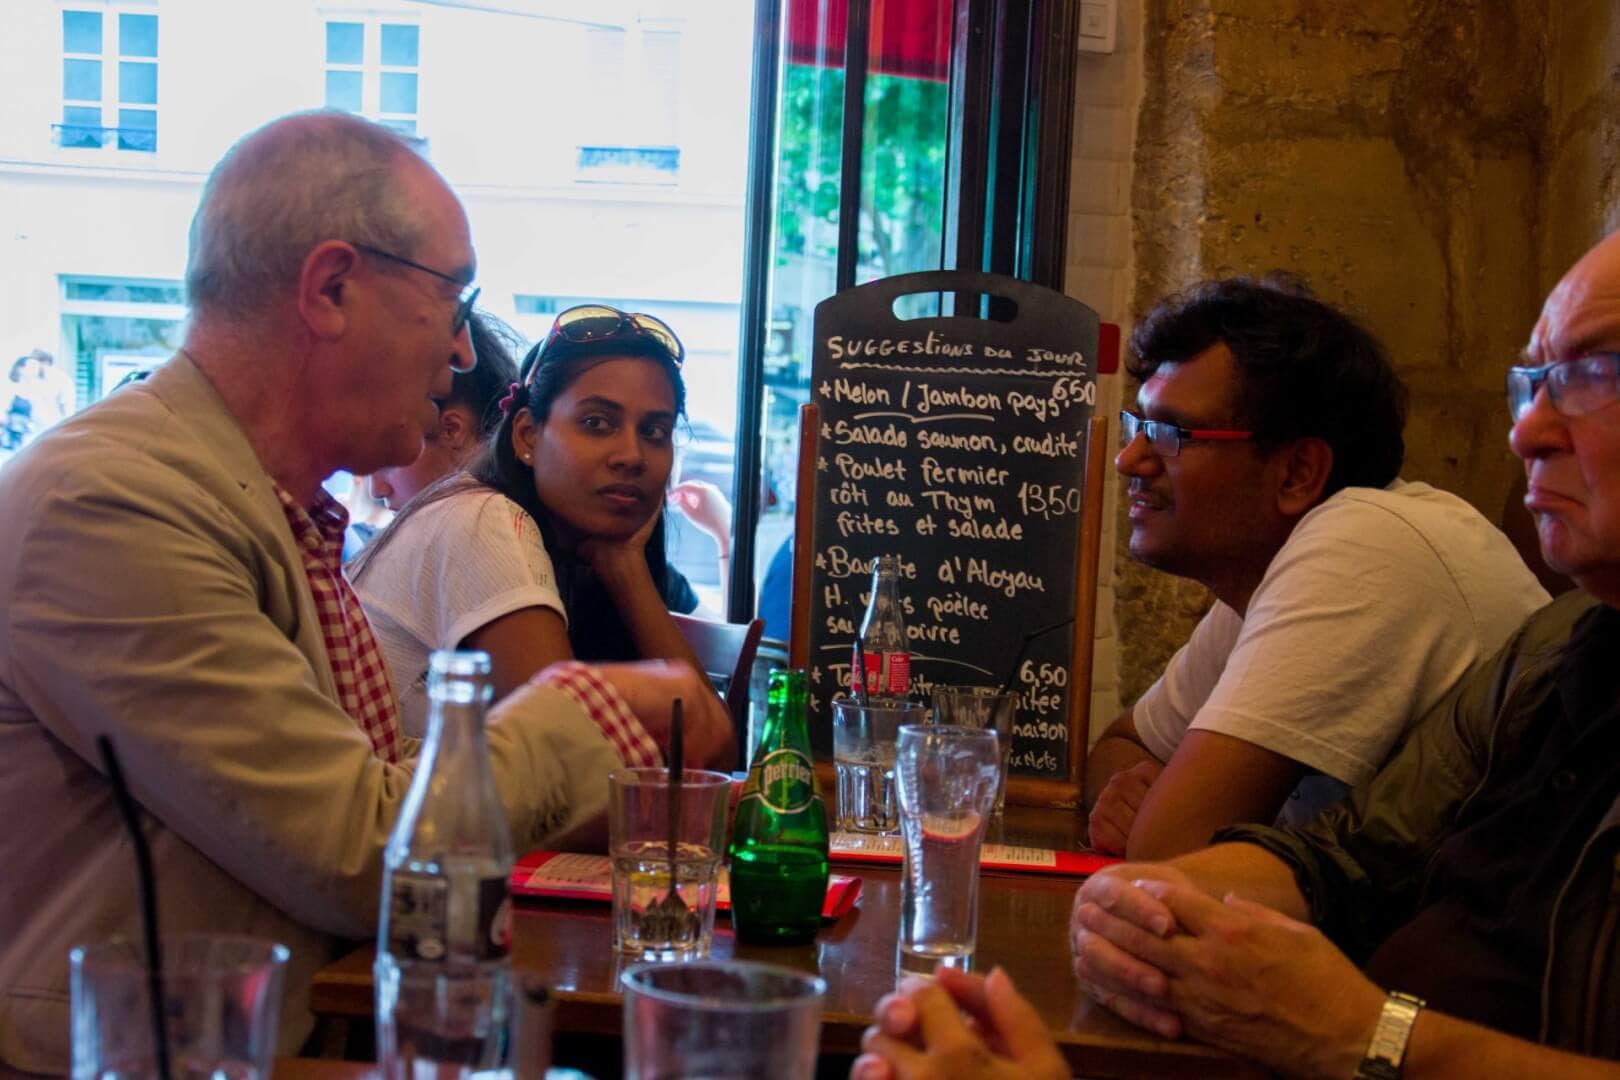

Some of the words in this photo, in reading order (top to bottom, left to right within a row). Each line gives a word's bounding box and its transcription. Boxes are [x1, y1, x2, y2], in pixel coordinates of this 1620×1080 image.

[834, 378, 891, 405] Melon
[917, 383, 1003, 413] Jambon
[834, 420, 908, 448] Salade
[835, 453, 907, 481] Poulet
[920, 456, 1009, 487] fermier
[886, 490, 914, 508] au
[920, 490, 996, 520] Thym
[1017, 482, 1081, 521] 13,50
[837, 511, 900, 538] frites
[915, 513, 938, 536] et
[948, 517, 1024, 540] salade
[1020, 659, 1068, 689] 6,50
